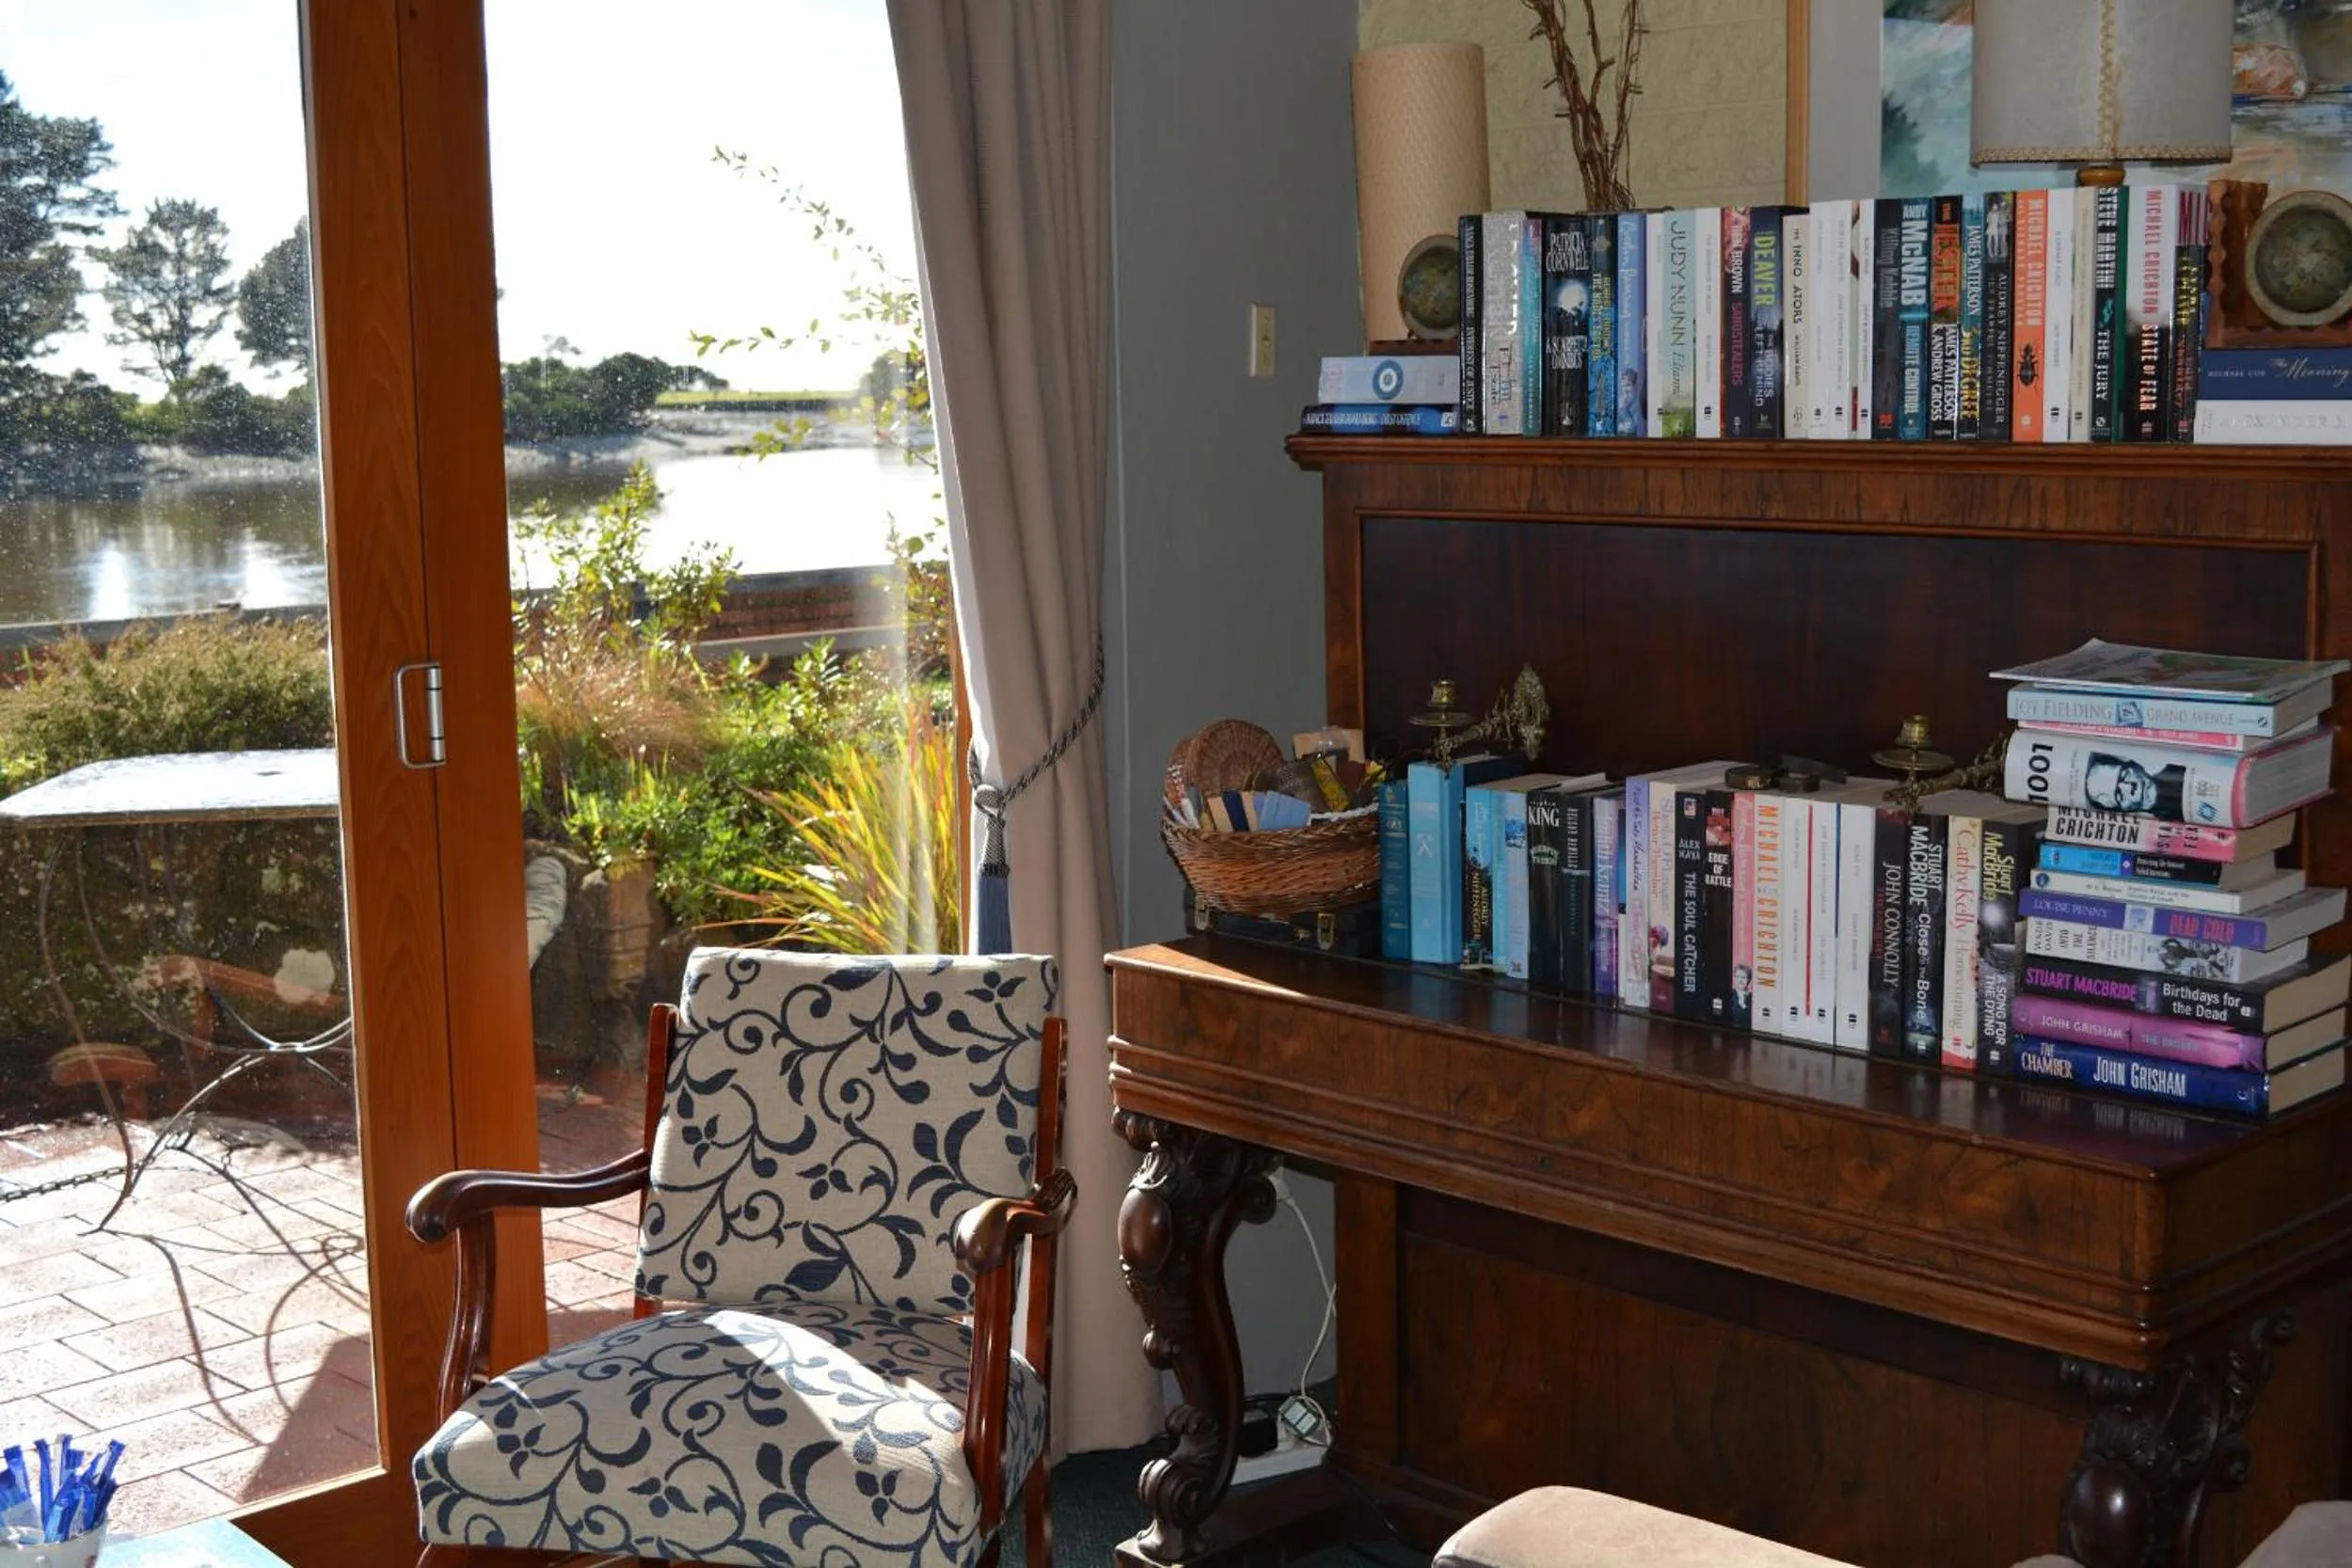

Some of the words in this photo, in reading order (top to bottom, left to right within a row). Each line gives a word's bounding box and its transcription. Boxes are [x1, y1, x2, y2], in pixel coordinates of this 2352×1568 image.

[1902, 204, 1928, 219] ANDY
[2098, 186, 2117, 227] STEVE
[2145, 189, 2163, 245] MICHAEL
[1550, 231, 1585, 253] PATRICIA
[1879, 227, 1899, 265] Killing
[1967, 225, 1981, 257] JAMES
[2029, 198, 2043, 257] MICHAEL
[1546, 250, 1589, 272] CORNWELL
[1672, 220, 1686, 280] JUDY
[1901, 220, 1929, 306] McNAB
[2097, 232, 2117, 289] MARTINI
[1732, 249, 1742, 294] BROWN
[1755, 236, 1776, 307] DEAVER
[1881, 267, 1899, 309] Kebble
[1967, 258, 1981, 316] PATTERSON
[2143, 251, 2161, 315] CRICHTON
[1996, 272, 2009, 325] AUDREY
[2027, 262, 2043, 327] CRICHTON
[1671, 284, 1687, 347] NUNN
[1731, 301, 1743, 388] SANDSTEALERS
[1755, 326, 1765, 355] LEFT
[1906, 325, 1920, 366] REMOTE
[1932, 335, 1944, 384] ANDREW
[1946, 324, 1958, 356] JAMES
[2098, 328, 2110, 360] THE
[2140, 323, 2158, 361] STATE
[1673, 352, 1685, 399] Elianne
[1755, 358, 1764, 407] BEHIND
[1764, 349, 1775, 399] BODIES
[1945, 358, 1957, 421] PATTERSON
[1961, 356, 1979, 420] DEGREE
[1994, 328, 2008, 424] NIFFENEGGER
[2095, 363, 2109, 402] JURY
[2143, 364, 2155, 375] OF
[2274, 356, 2350, 388] Meaning
[1905, 368, 1920, 414] CONTROL
[1931, 384, 1943, 421] GROSS
[2139, 379, 2157, 412] FEAR
[2013, 697, 2042, 718] JOY
[2042, 698, 2113, 722] FIELDING
[2026, 742, 2055, 802] 1001
[1527, 806, 1561, 827] KING
[2056, 816, 2140, 845] CRICHTON
[1677, 838, 1701, 850] ALEX
[1708, 852, 1729, 864] EDGE
[1758, 804, 1779, 884] MICHAEL
[1953, 829, 1977, 887] Cathy
[1685, 871, 1697, 897] THE
[1705, 874, 1733, 888] BATTLE
[1713, 863, 1724, 875] OF
[1882, 860, 1902, 905] JOHN
[1909, 825, 1930, 907] MACBRIDE
[1928, 843, 1944, 892] STUART
[1984, 831, 2003, 901] MacBride
[1996, 854, 2015, 896] Stuart
[1481, 887, 1489, 927] AUDREY
[1685, 899, 1697, 931] SOUL
[1952, 887, 1977, 931] Kelly
[2032, 897, 2071, 913] LOUISE
[1756, 897, 1779, 989] CRICHTON
[1917, 912, 1931, 958] Close
[2169, 913, 2200, 938] DEAD
[2202, 918, 2236, 942] COLD
[1683, 932, 1697, 993] CATCHER
[1883, 907, 1901, 990] CONNOLLY
[1950, 938, 1970, 1032] Homecoming
[1985, 975, 1995, 999] THE
[1996, 974, 2006, 984] A
[2026, 967, 2072, 990] STUART
[2073, 974, 2139, 1002] MACBRIDE
[2163, 982, 2220, 1006] Birthdays
[2222, 990, 2243, 1008] for
[1916, 979, 1931, 1021] Bone
[1985, 999, 1995, 1037] DYING
[1996, 985, 2007, 1019] SONG
[2172, 1001, 2192, 1018] the
[2196, 1004, 2229, 1022] Dead
[1996, 1021, 2007, 1047] FOR
[2040, 1015, 2072, 1031] JOHN
[2073, 1021, 2124, 1041] GRISHAM
[2021, 1052, 2074, 1080] CHAMBER
[2040, 1041, 2056, 1057] THE
[2093, 1055, 2126, 1086] JOHN
[2130, 1062, 2187, 1099] GRISHAM
